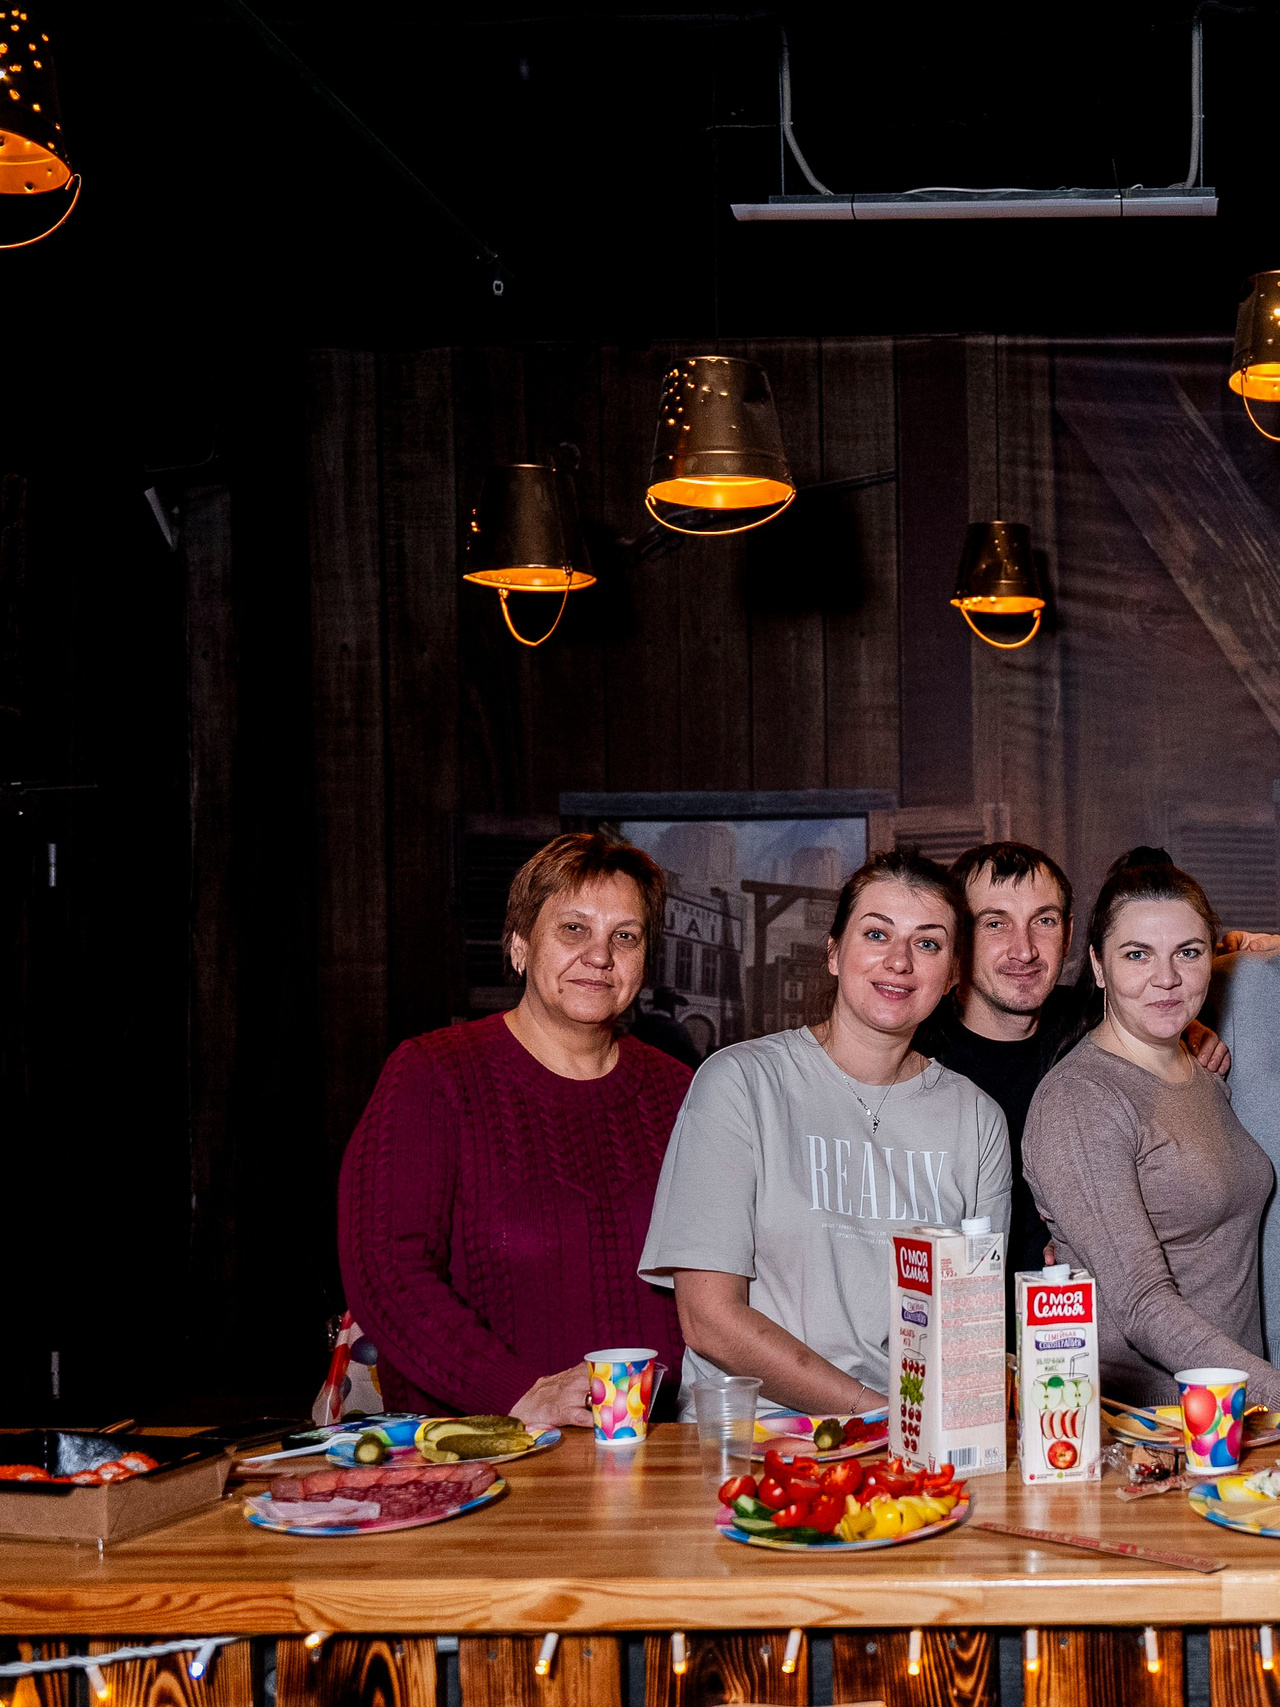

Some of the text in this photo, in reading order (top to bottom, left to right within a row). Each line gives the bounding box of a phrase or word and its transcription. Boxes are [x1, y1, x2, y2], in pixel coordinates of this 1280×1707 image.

[806, 1135, 948, 1225] REALLY
[900, 1246, 930, 1283] Семья
[1033, 1291, 1086, 1319] Семья
